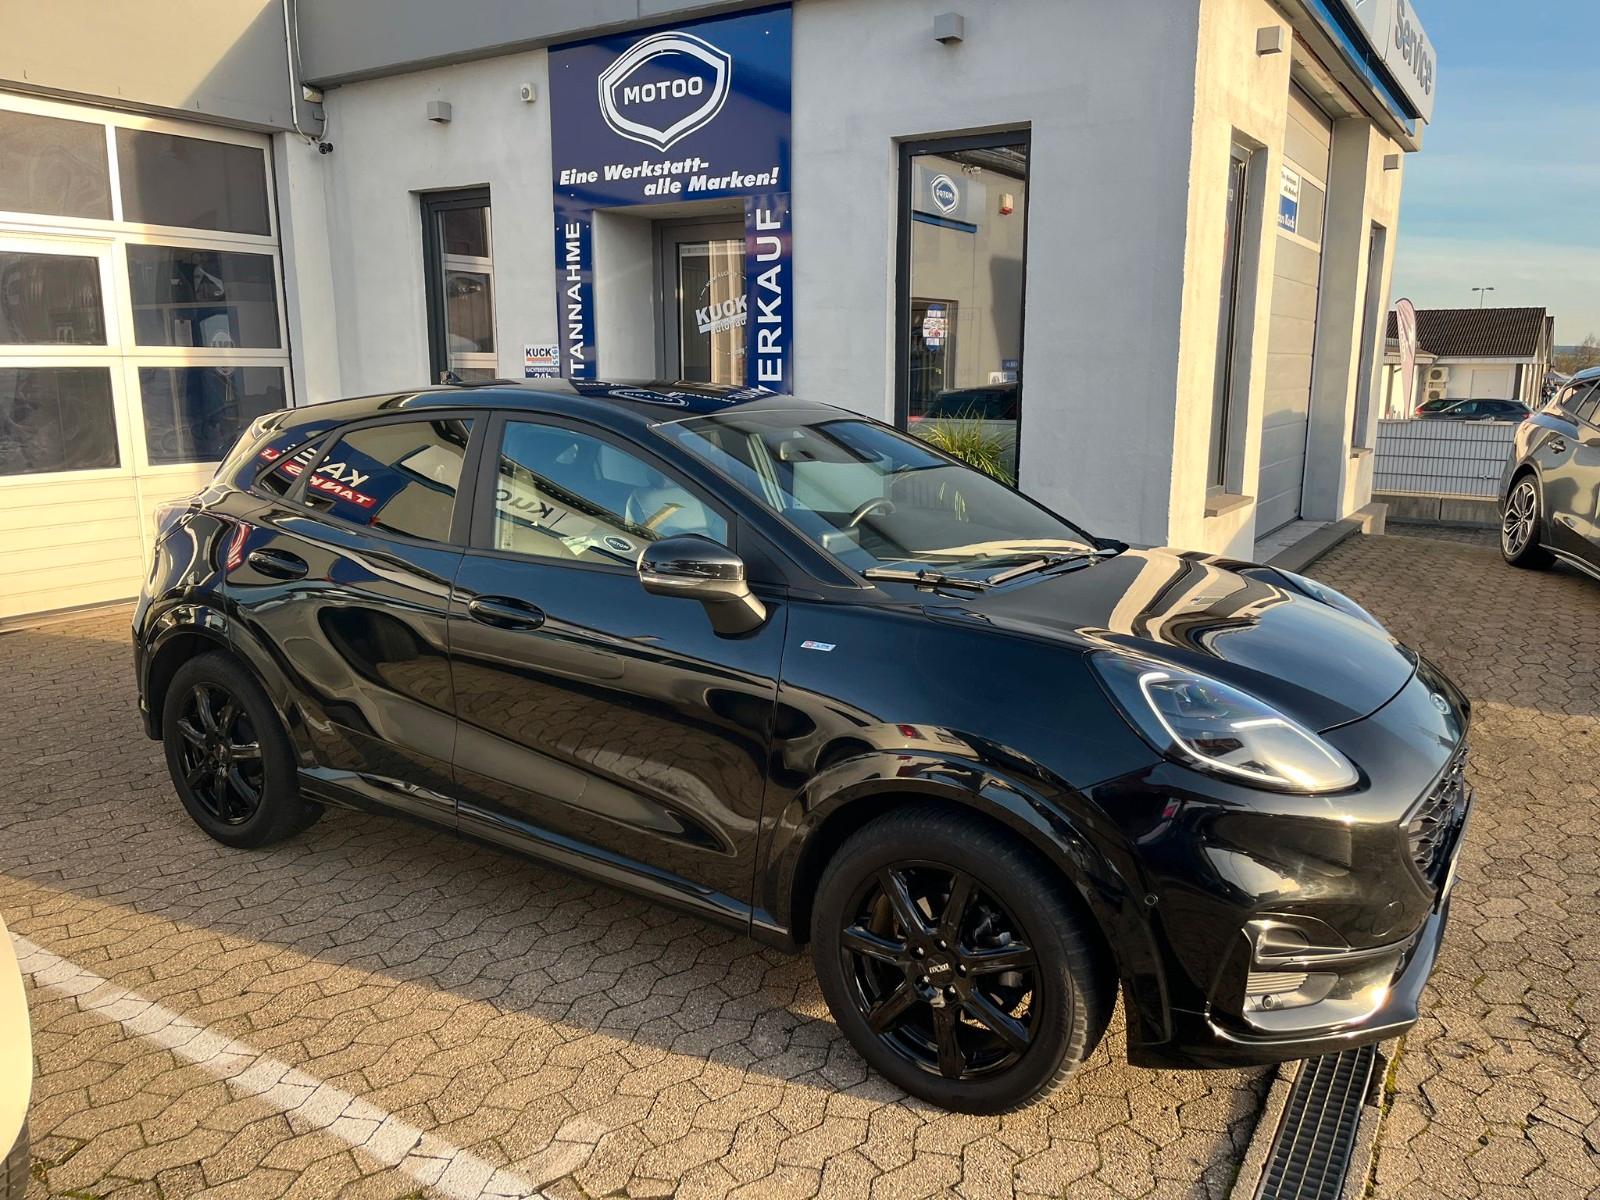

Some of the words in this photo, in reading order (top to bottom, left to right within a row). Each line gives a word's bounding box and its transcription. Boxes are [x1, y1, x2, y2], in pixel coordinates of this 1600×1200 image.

[1394, 0, 1432, 95] Service
[624, 76, 703, 105] MOTOO
[560, 168, 598, 186] Eine
[604, 157, 709, 181] Werkstatt-
[644, 177, 681, 196] alle
[688, 166, 780, 192] Marken!
[565, 222, 585, 380] TANNAHME
[525, 348, 552, 357] KUCK
